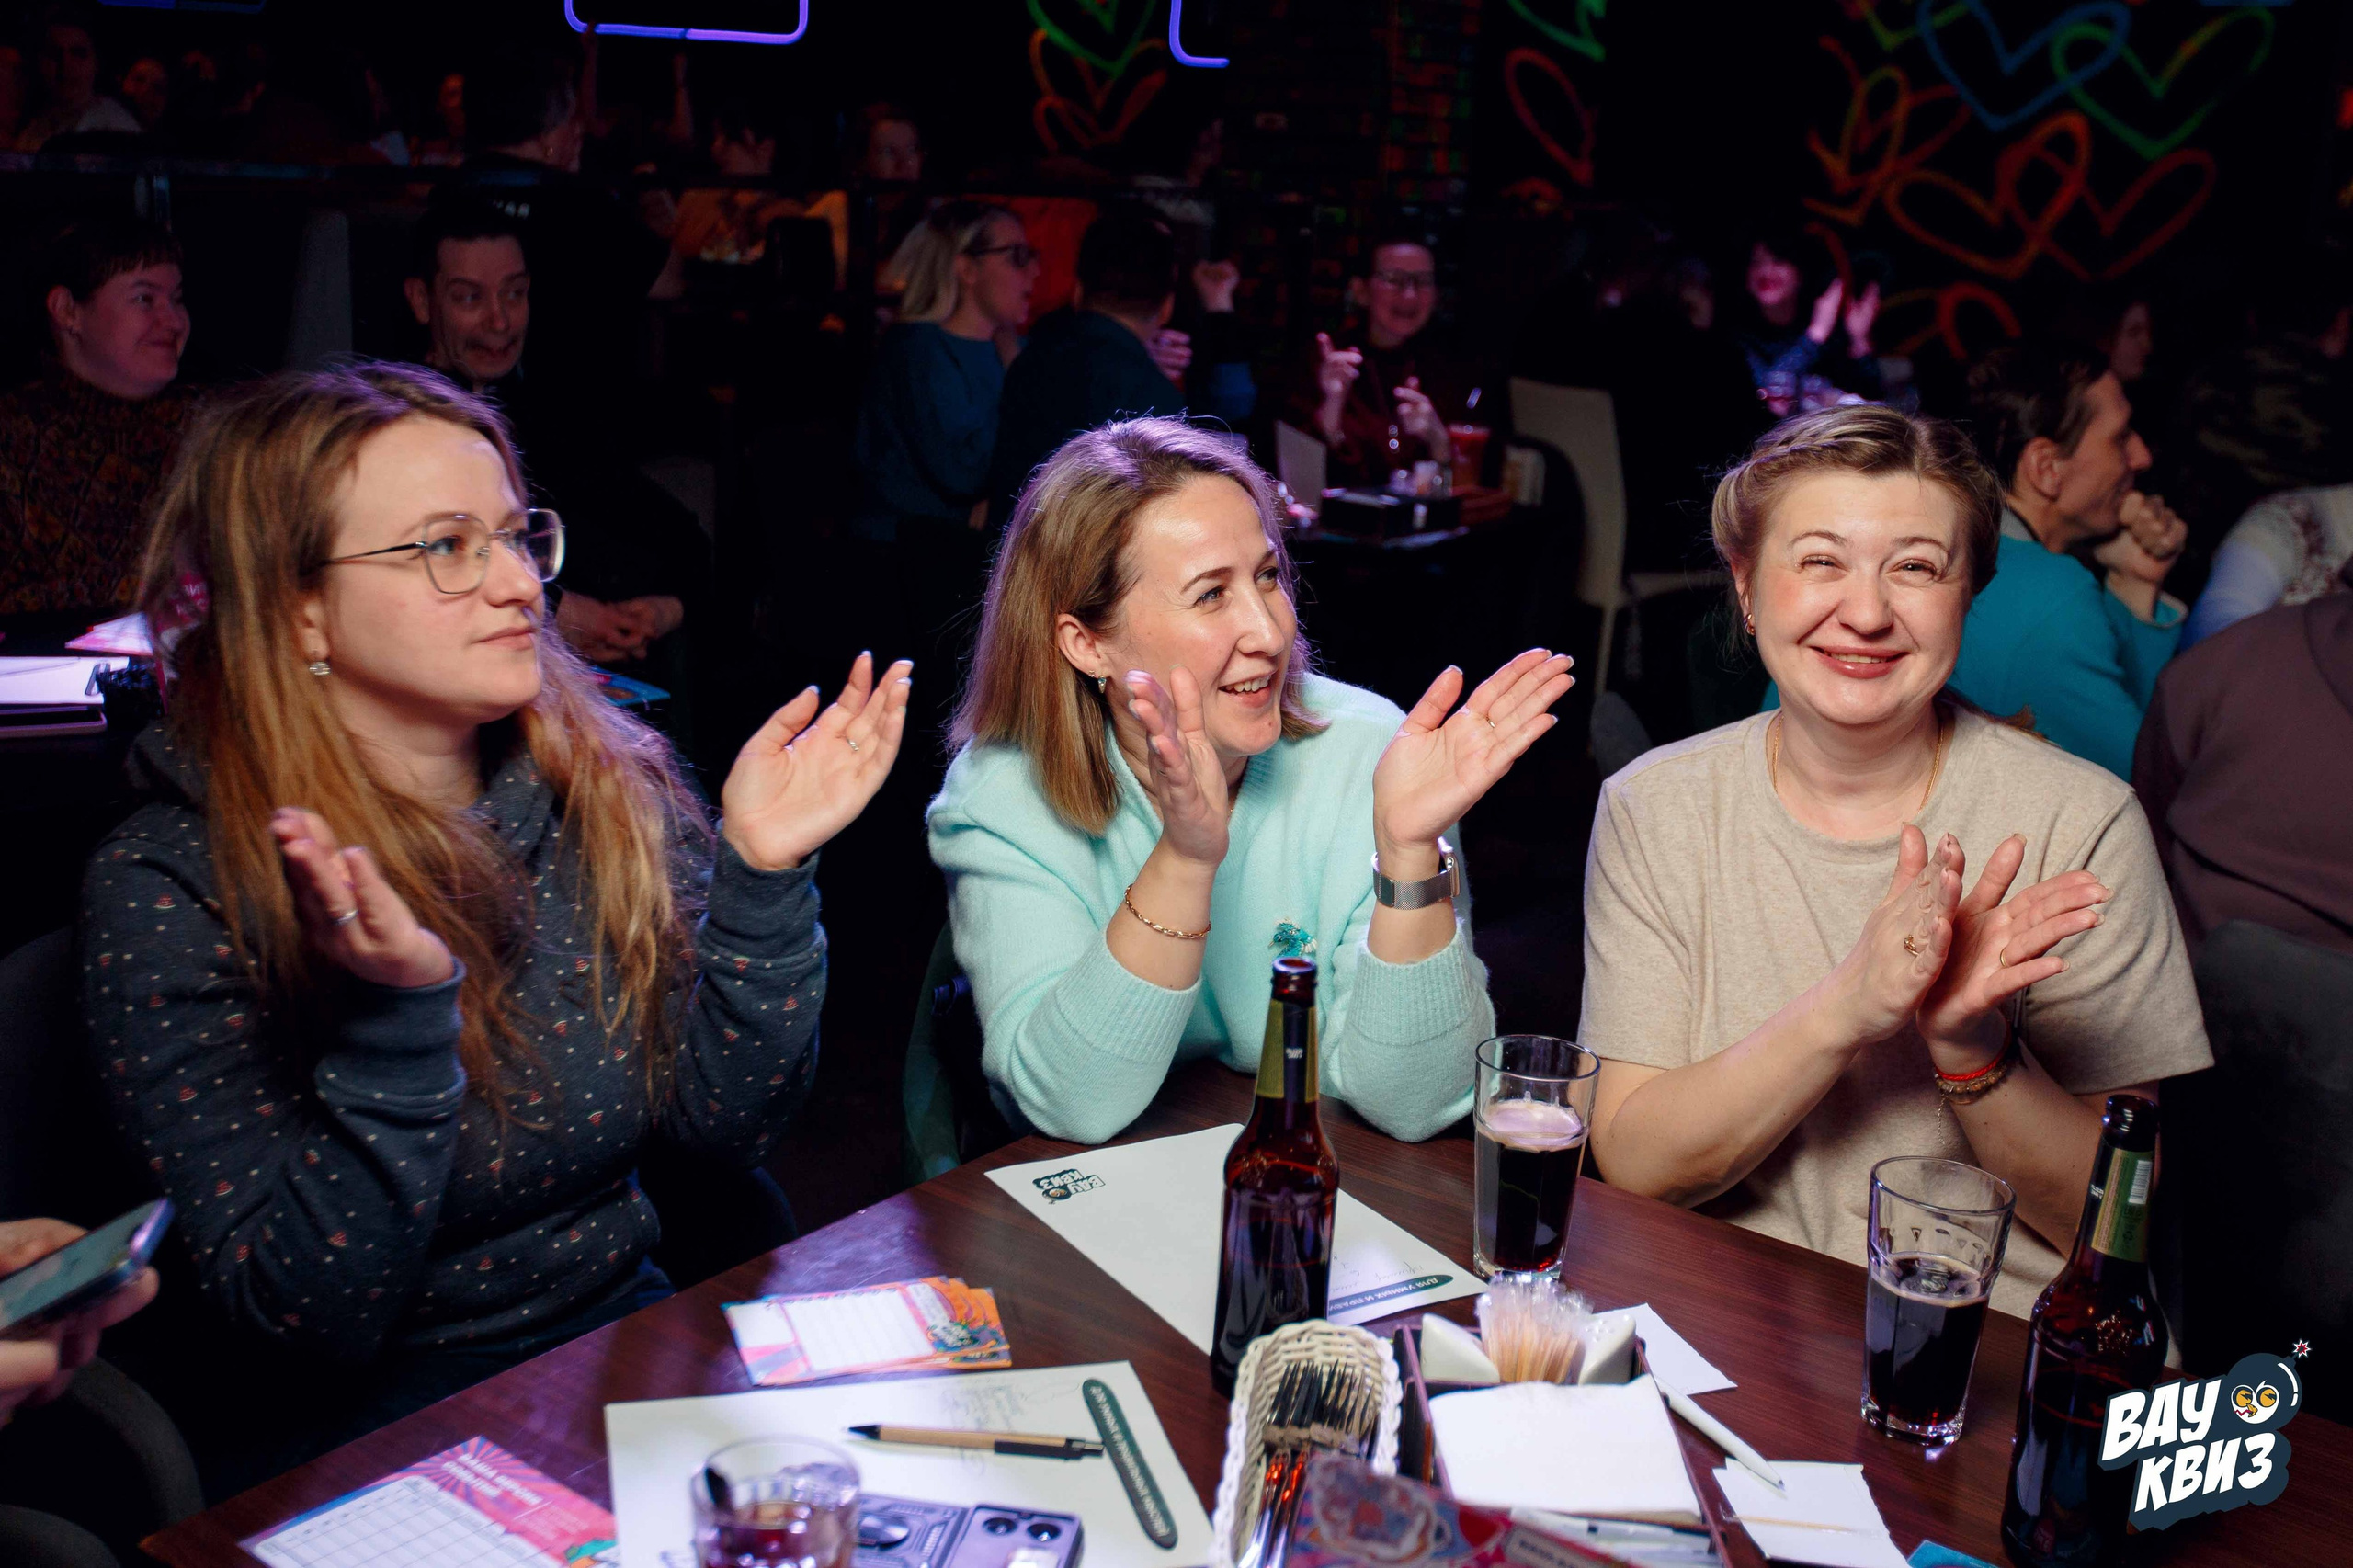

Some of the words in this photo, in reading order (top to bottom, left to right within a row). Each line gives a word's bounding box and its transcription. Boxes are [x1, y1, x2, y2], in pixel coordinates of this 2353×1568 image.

[1040, 1170, 1084, 1190] КВИЗ
[1067, 1175, 1105, 1195] ВАУ
[1415, 1277, 1439, 1289] ДЛЯ
[1364, 1294, 1375, 1302] И
[1376, 1284, 1416, 1300] УМНЫХ
[1329, 1297, 1365, 1311] ПРАВИ
